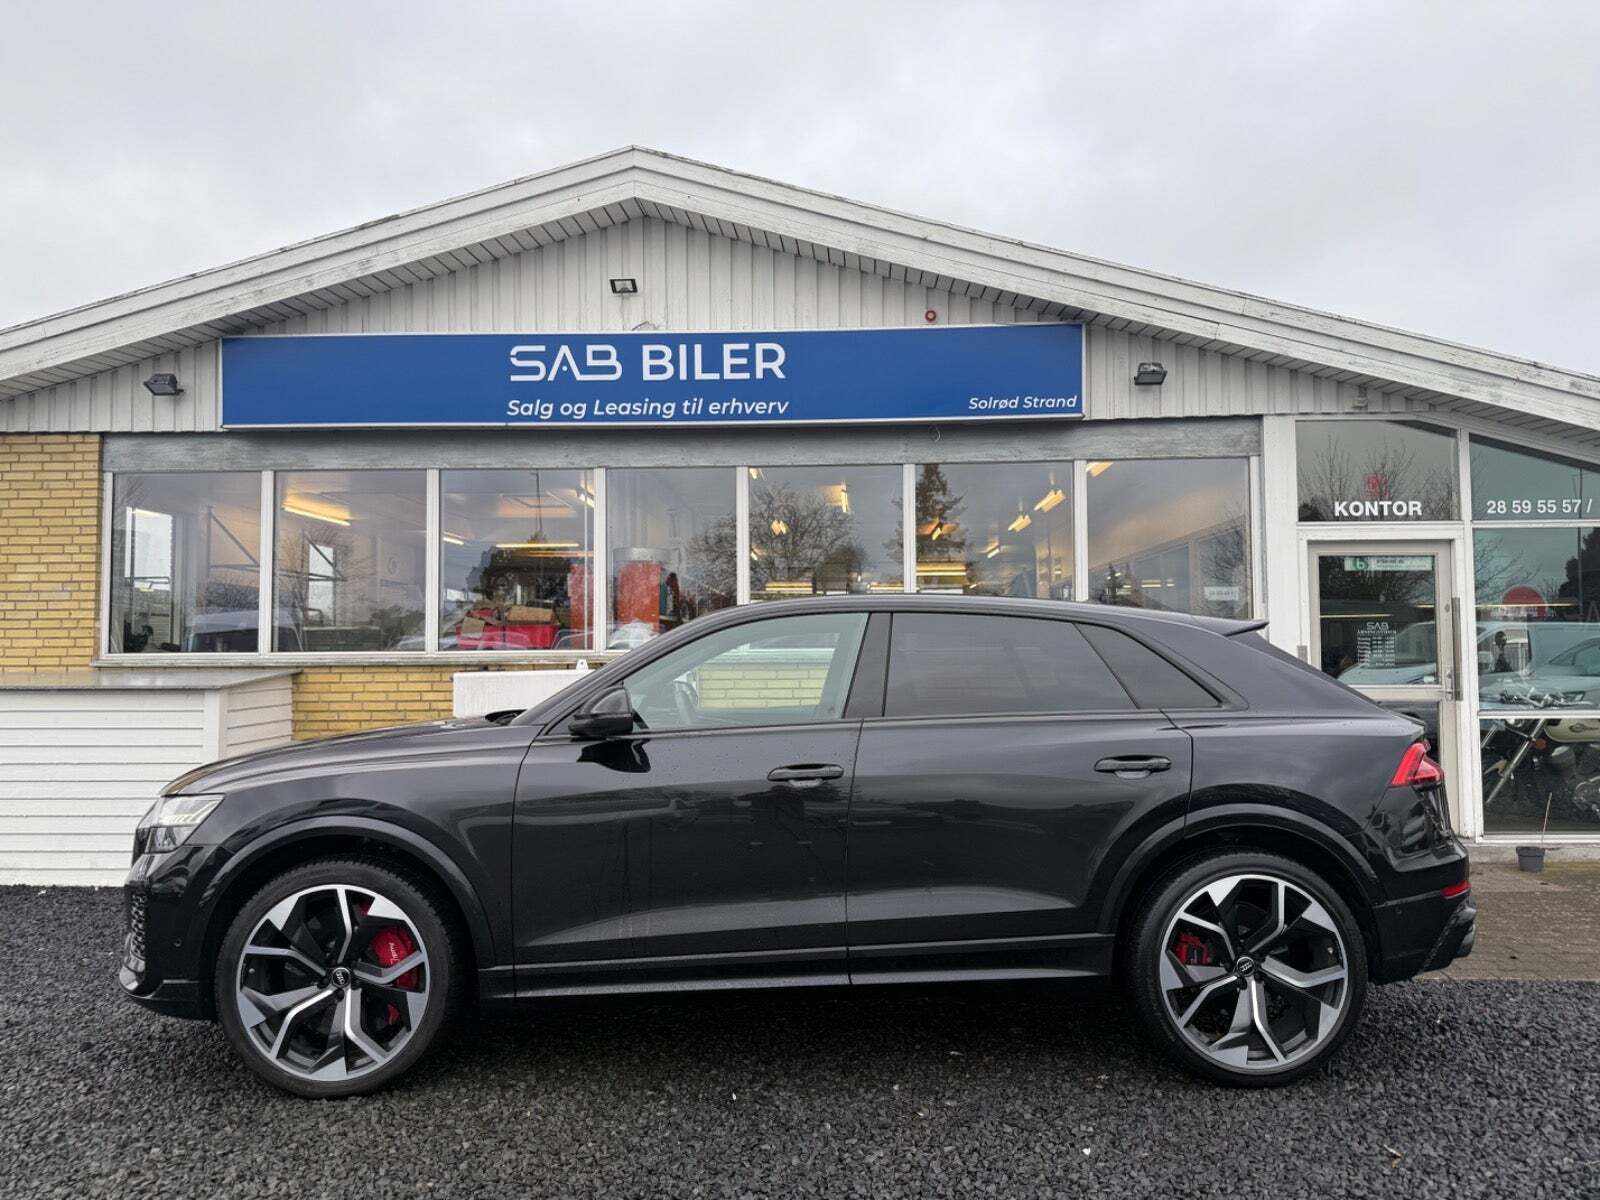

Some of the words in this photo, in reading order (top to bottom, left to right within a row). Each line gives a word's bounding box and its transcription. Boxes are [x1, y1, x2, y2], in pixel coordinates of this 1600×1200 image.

[509, 344, 623, 382] SAB
[642, 342, 786, 382] BILER
[507, 399, 554, 420] Salg
[560, 401, 587, 419] og
[593, 398, 676, 418] Leasing
[682, 397, 703, 415] til
[708, 397, 790, 415] erhverv
[968, 395, 1020, 410] Solrød
[1022, 395, 1078, 408] Strand
[1334, 500, 1423, 517] KONTOR
[1486, 499, 1507, 514] 28
[1512, 499, 1532, 514] 59
[1537, 499, 1557, 514] 55
[1562, 499, 1582, 513] 57
